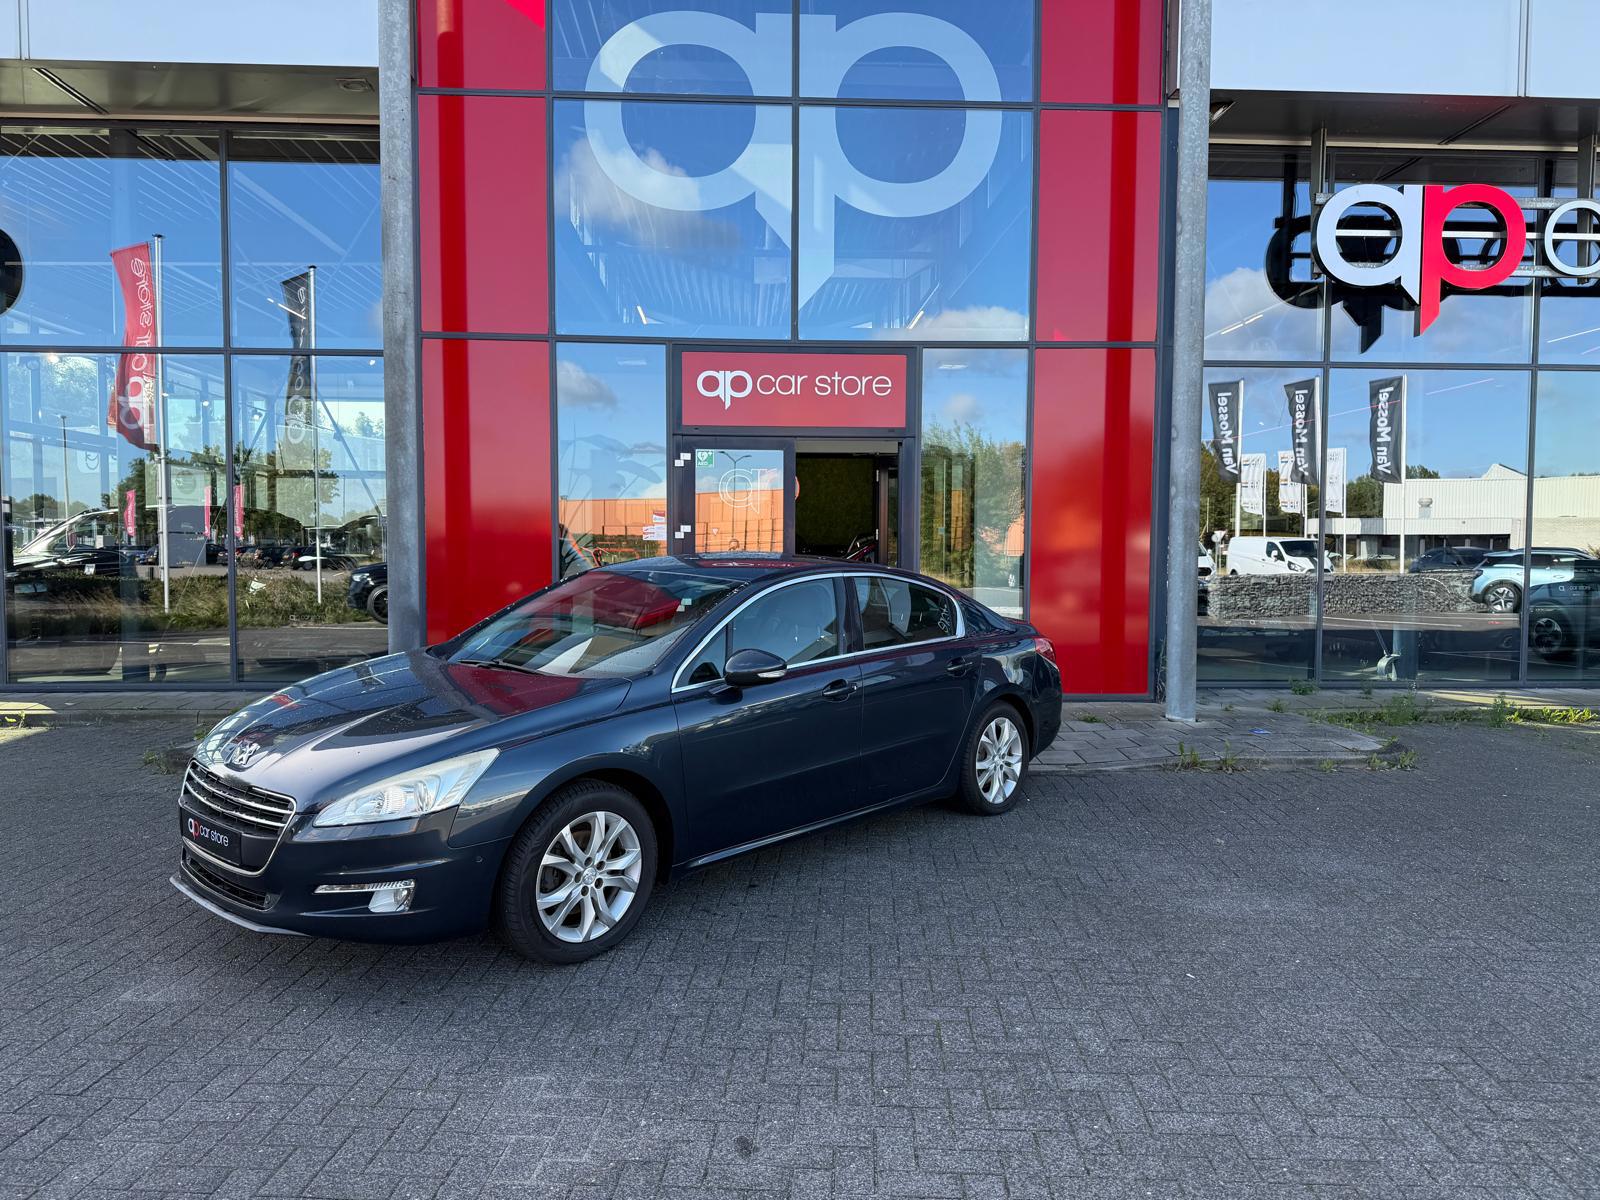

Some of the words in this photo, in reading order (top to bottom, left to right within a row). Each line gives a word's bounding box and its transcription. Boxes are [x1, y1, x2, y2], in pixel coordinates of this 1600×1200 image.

[1316, 184, 1527, 335] ap
[697, 371, 753, 410] ap
[757, 375, 808, 395] car
[815, 372, 892, 396] store
[200, 825, 211, 839] car
[211, 830, 229, 847] store
